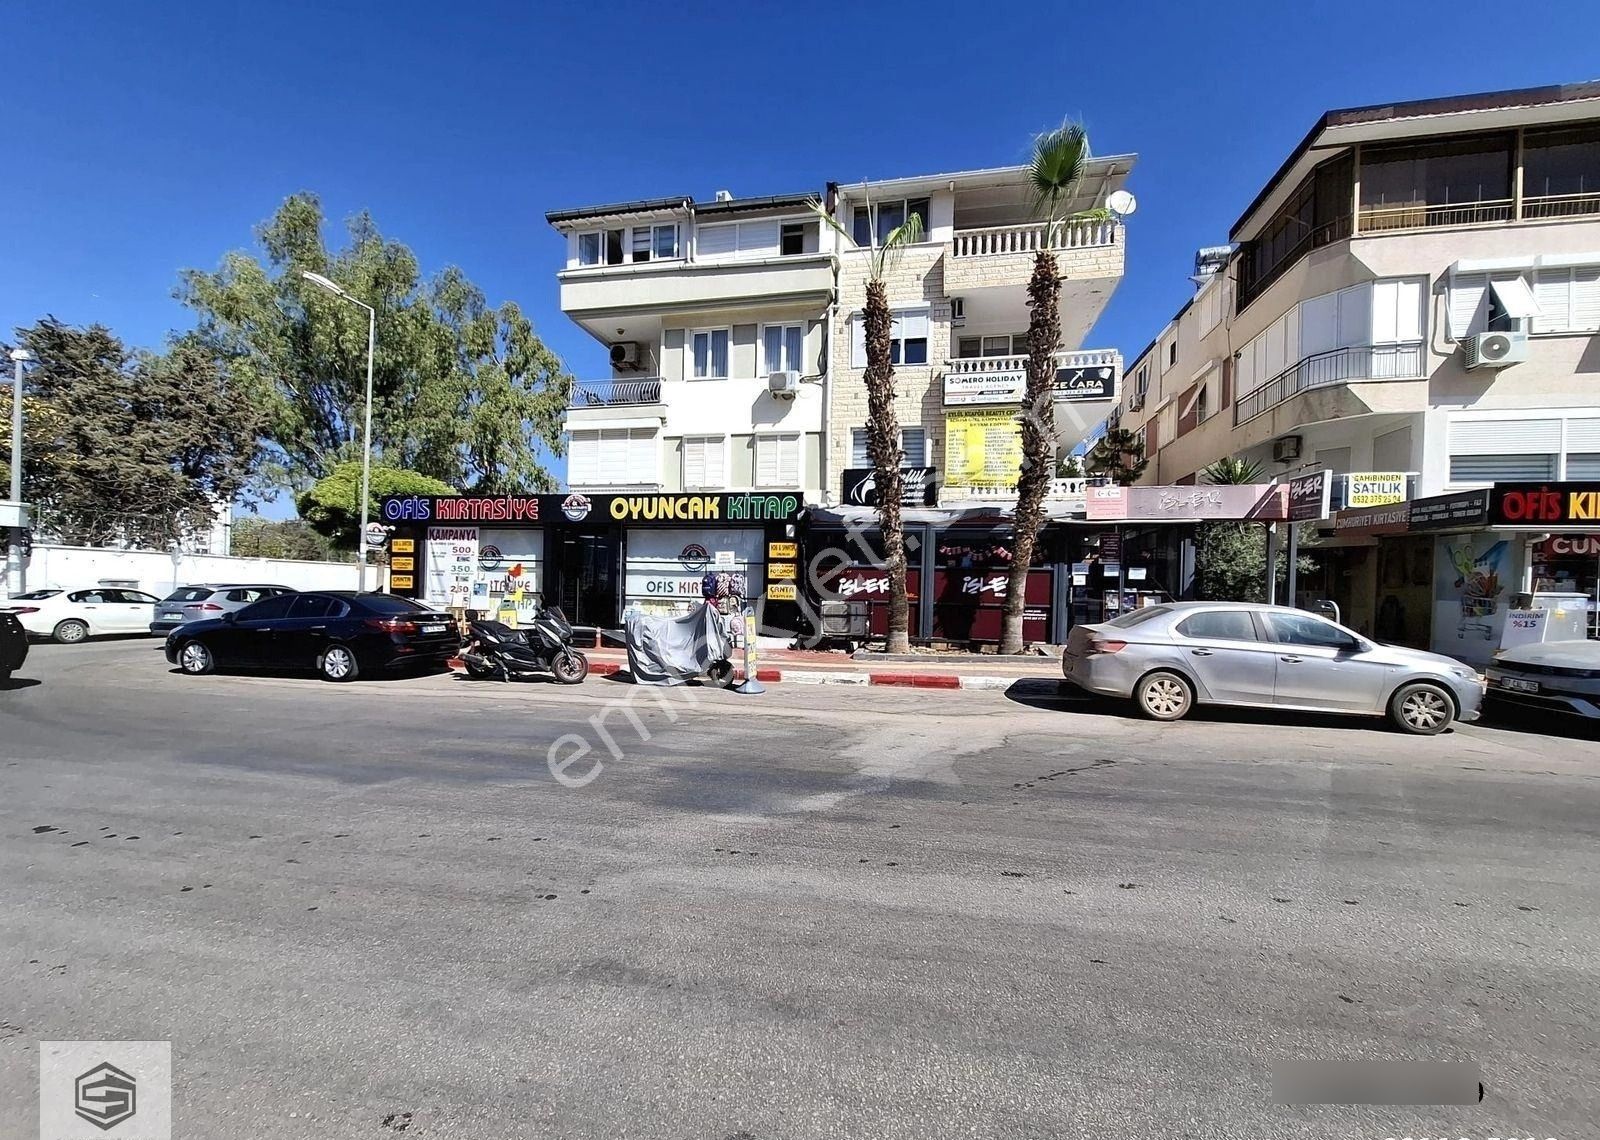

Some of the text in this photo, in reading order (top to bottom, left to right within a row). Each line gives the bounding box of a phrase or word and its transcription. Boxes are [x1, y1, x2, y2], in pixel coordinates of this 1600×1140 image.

[949, 375, 1022, 384] SOMERO HOLIDAY
[1353, 482, 1401, 494] SATILIK
[385, 495, 539, 520] OFİS KIRTASİYE
[610, 492, 798, 520] OYUNCAK KİTAP
[1503, 486, 1600, 520] OFİS KI
[428, 528, 477, 541] KAMPANYA
[452, 546, 471, 554] 500
[451, 565, 470, 573] 350
[679, 582, 703, 593] KIR
